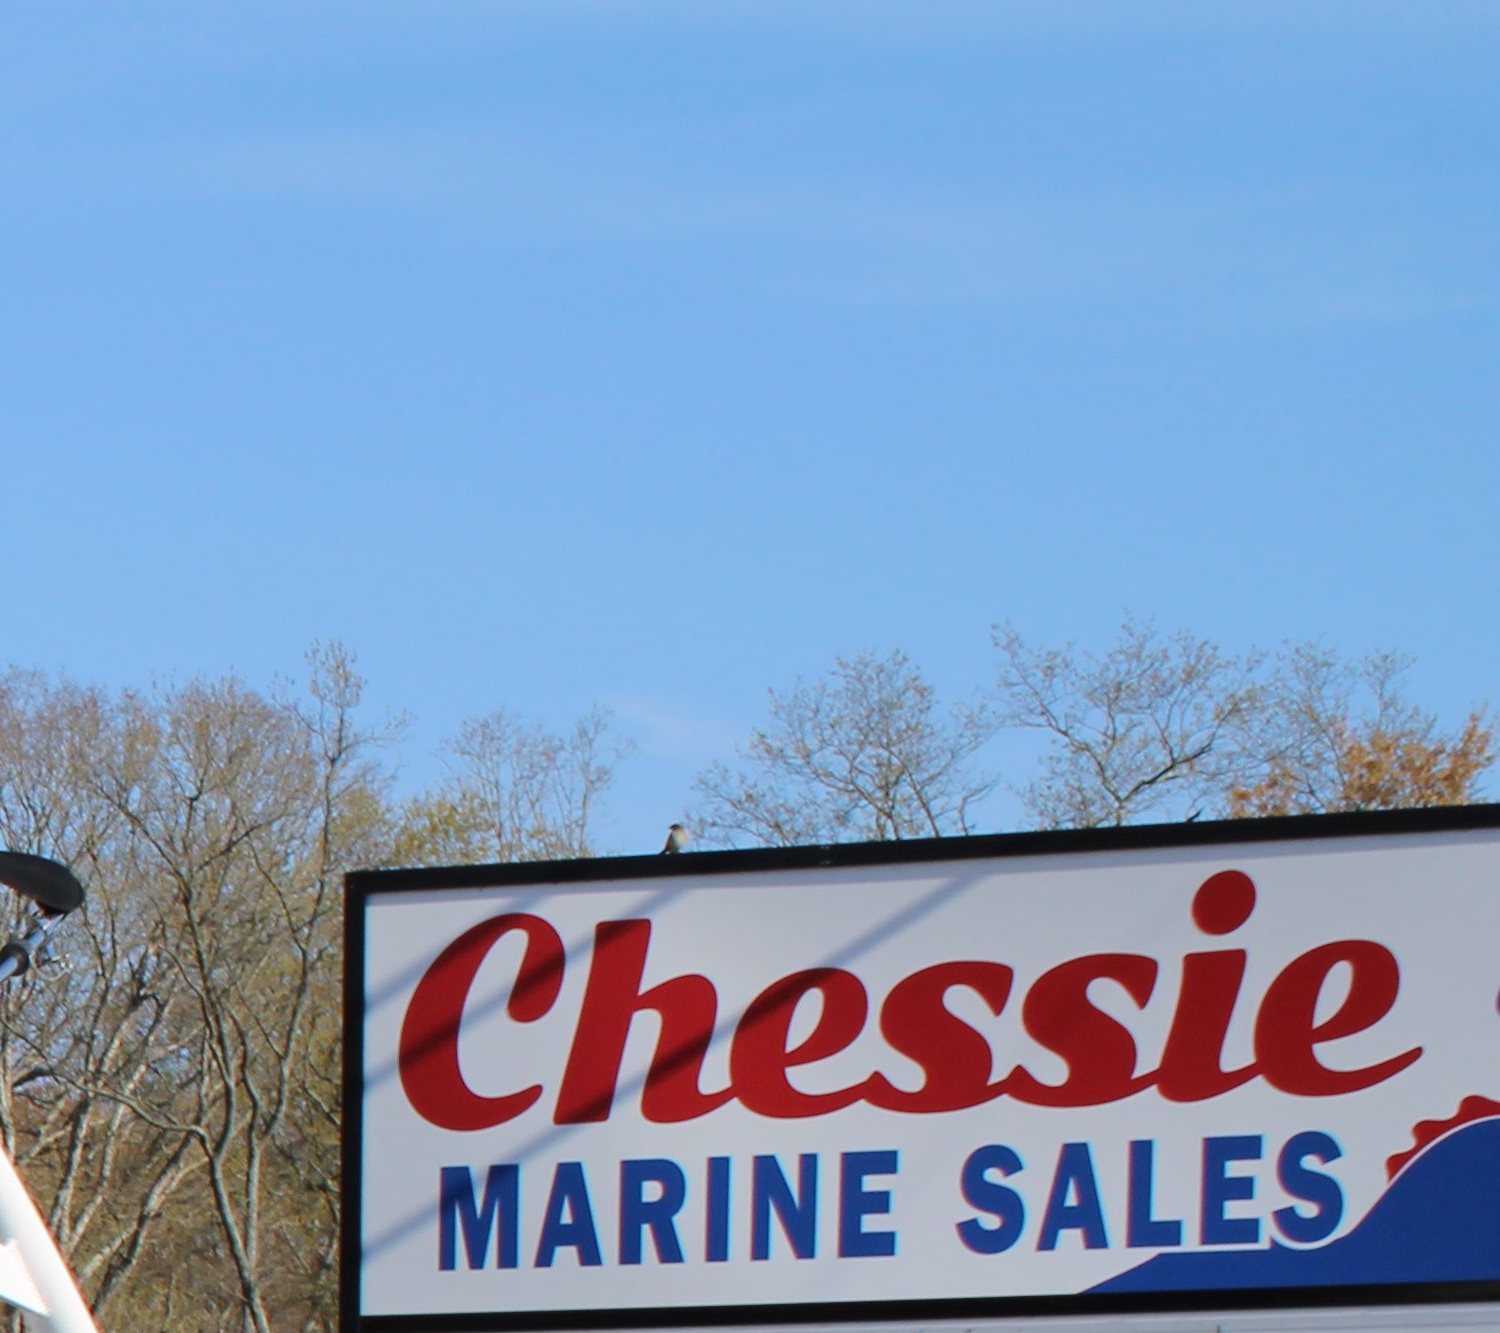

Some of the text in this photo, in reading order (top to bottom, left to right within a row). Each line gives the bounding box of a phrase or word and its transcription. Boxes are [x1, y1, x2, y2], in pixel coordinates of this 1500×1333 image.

[399, 871, 1424, 1132] Chessie
[437, 1130, 1345, 1272] MARINE SALES
